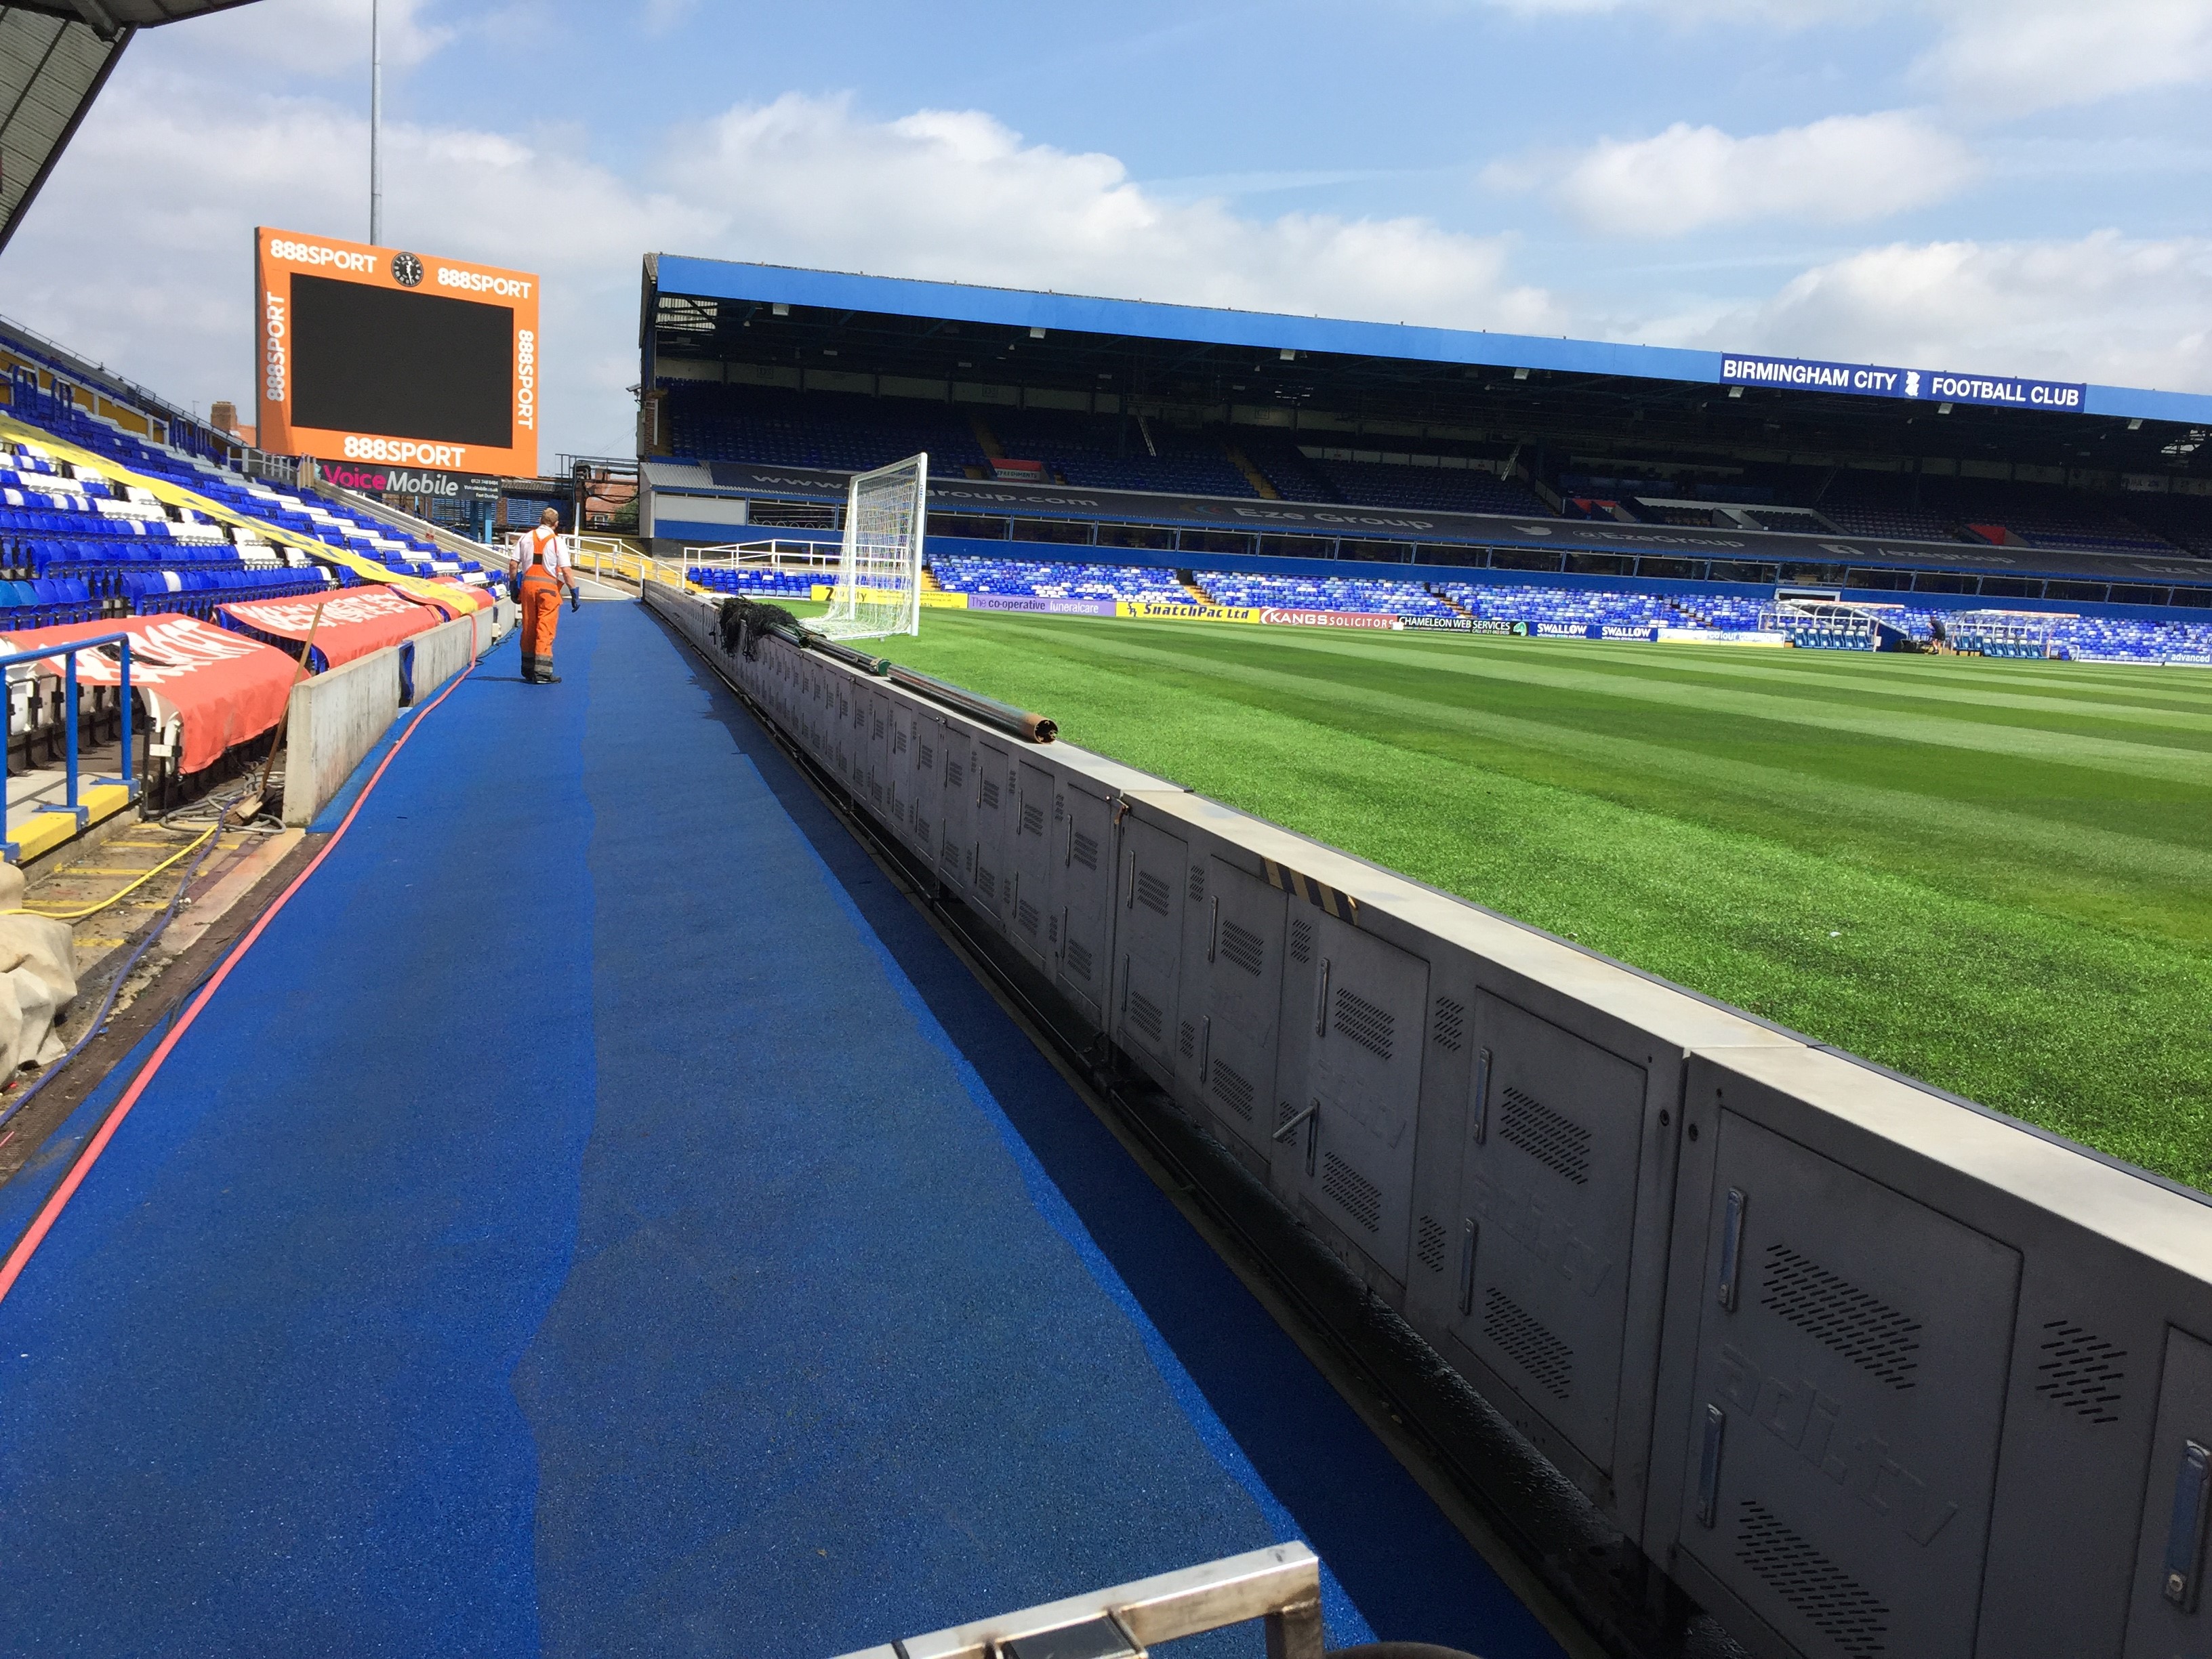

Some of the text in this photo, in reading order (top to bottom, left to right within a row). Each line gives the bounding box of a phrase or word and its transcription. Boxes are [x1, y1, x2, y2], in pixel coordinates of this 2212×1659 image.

[270, 239, 377, 274] 888SPORT
[437, 267, 531, 299] 888SPORT
[266, 291, 285, 401] 888SPORT
[518, 329, 534, 430] 888SPORT
[1723, 360, 2078, 407] BIRMINGHAM CITY FOOTBALL CLUB
[344, 436, 466, 468] 888SPORT
[1233, 507, 1434, 530] Eze Group
[971, 597, 1099, 613] The co-operative funeralcare
[1143, 604, 1249, 619] SnatchPac Ltd
[1270, 612, 1327, 626] KANGS
[1453, 619, 1472, 628] WEB
[1473, 620, 1511, 630] SERVICES
[1537, 623, 1587, 634] SWALLOW
[1601, 626, 1651, 637] SWALLOW
[2171, 653, 2211, 662] advanced
